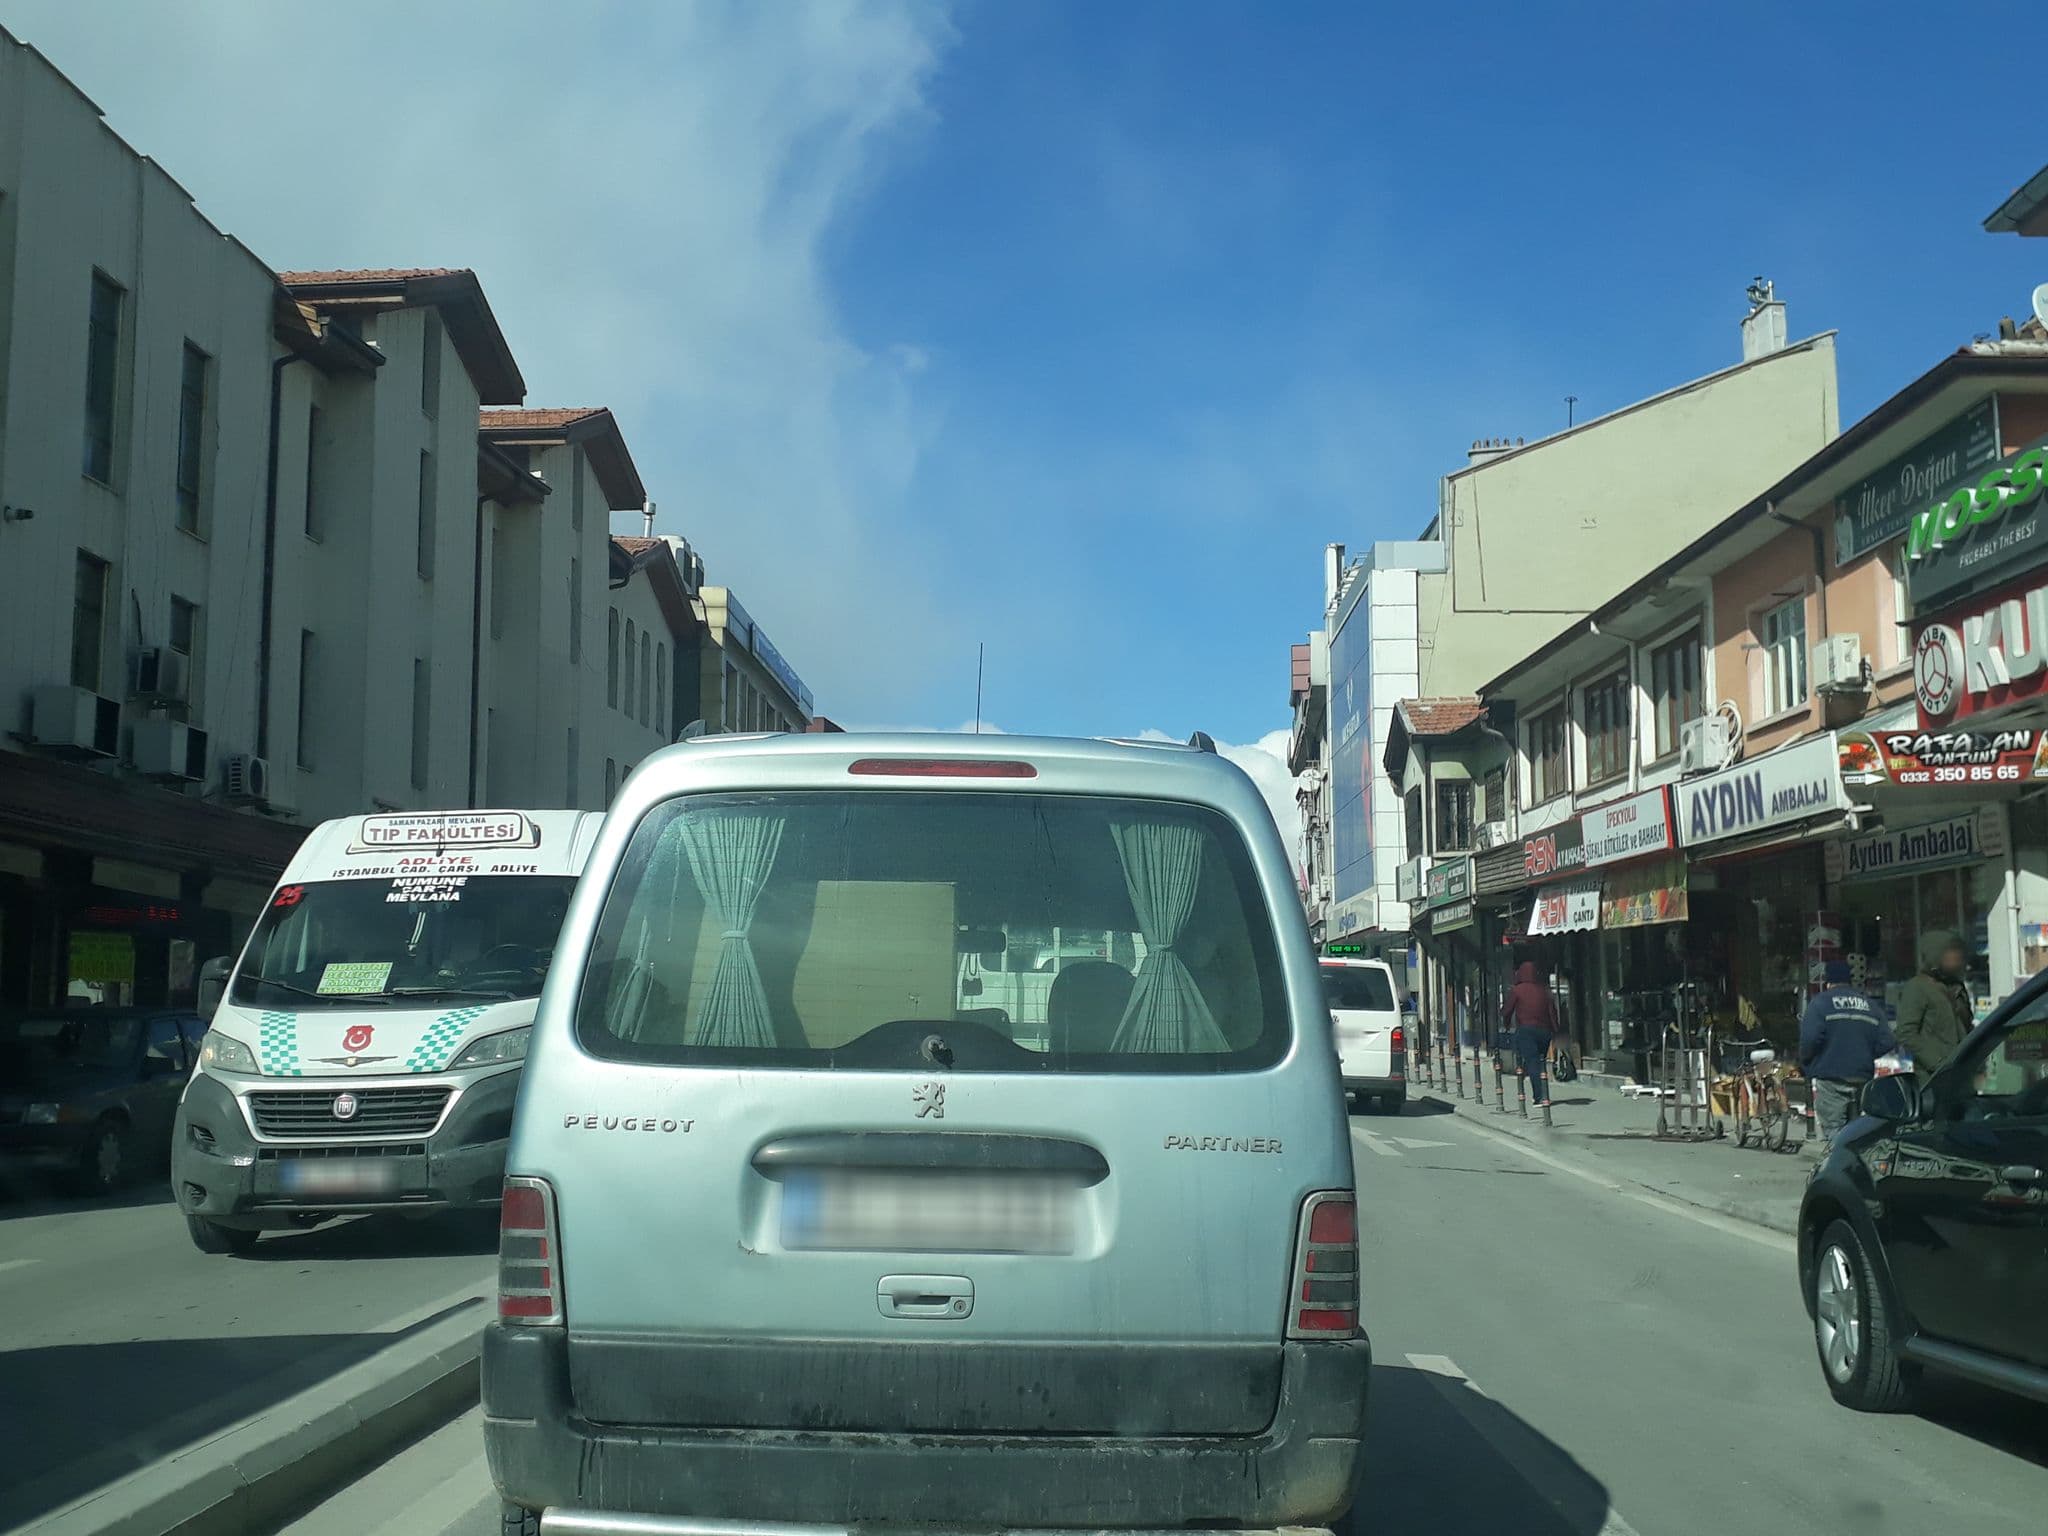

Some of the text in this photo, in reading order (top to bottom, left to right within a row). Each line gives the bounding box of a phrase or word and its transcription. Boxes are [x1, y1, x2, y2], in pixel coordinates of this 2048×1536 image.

[1905, 446, 2048, 562] MOSS
[2000, 529, 2015, 550] THE
[2015, 519, 2037, 543] BEST
[1918, 627, 1947, 656] KUBA
[1918, 676, 1953, 712] MOTOR
[1900, 771, 1930, 783] 0332
[1934, 767, 1966, 781] 350
[1970, 766, 1992, 780] 85
[1997, 765, 2020, 780] 65
[1691, 769, 1828, 838] AYDIN AMBALAJ
[369, 828, 400, 841] TIP
[1630, 834, 1637, 850] ve
[1638, 822, 1665, 848] BAHARAT
[1899, 818, 1973, 862] Ambalaj
[1524, 832, 1557, 878] RSN
[400, 866, 430, 874] CAD.
[391, 876, 468, 888] NUMUNE
[274, 885, 305, 907] 25
[385, 891, 460, 903] MEVLANA
[1537, 888, 1568, 930] RSN
[1573, 909, 1594, 927] ÇANTA
[338, 1101, 353, 1113] FIAT
[563, 1114, 695, 1133] PEUGEOT
[1163, 1135, 1283, 1154] PARTNER
